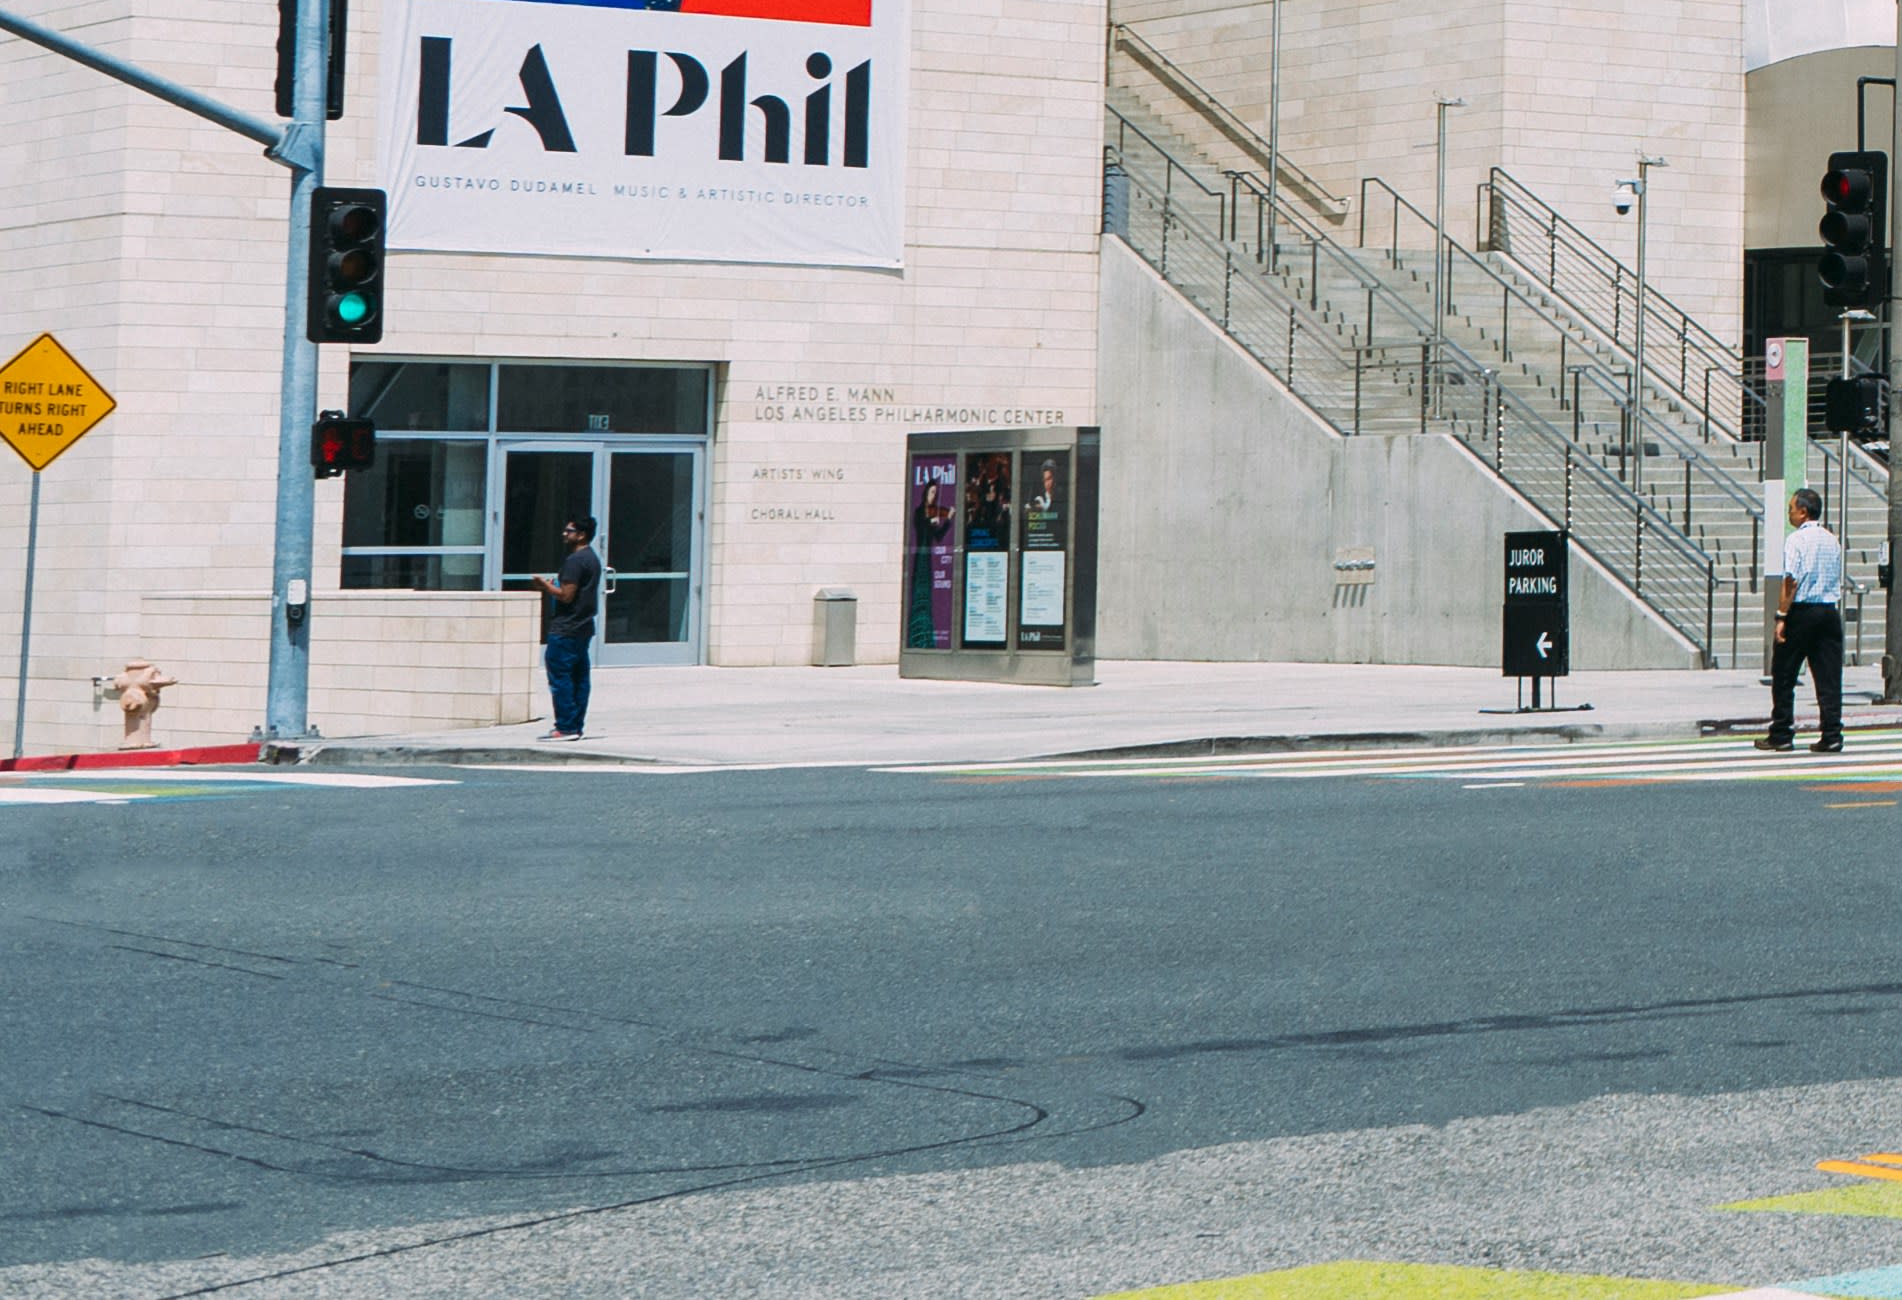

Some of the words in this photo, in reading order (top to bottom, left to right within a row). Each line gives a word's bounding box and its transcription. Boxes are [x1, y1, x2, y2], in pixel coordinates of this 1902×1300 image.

[416, 36, 578, 153] LA
[625, 49, 871, 168] Phil
[415, 175, 501, 191] GUSTAVO
[511, 179, 598, 196] DUDAMEL
[614, 184, 668, 200] MUSIC
[678, 187, 688, 200] &
[697, 188, 774, 204] ARTISTIC
[784, 191, 869, 207] DIRECTOR
[4, 381, 44, 395] RIGHT
[48, 383, 84, 397] LANE
[755, 385, 819, 401] ALFRED
[826, 387, 840, 401] E.
[848, 388, 895, 401] MANN
[47, 403, 87, 416] RIGHT
[755, 406, 785, 421] LOS
[792, 406, 868, 421] ANGELES
[874, 408, 998, 424] PHILHARMONIC
[1003, 409, 1064, 425] CENTER
[18, 423, 64, 436] AHEAD
[811, 468, 845, 481] WING
[751, 508, 800, 521] CHORAL
[805, 508, 835, 521] HALL
[1509, 548, 1545, 566] JUROR
[1509, 576, 1557, 594] PARKING
